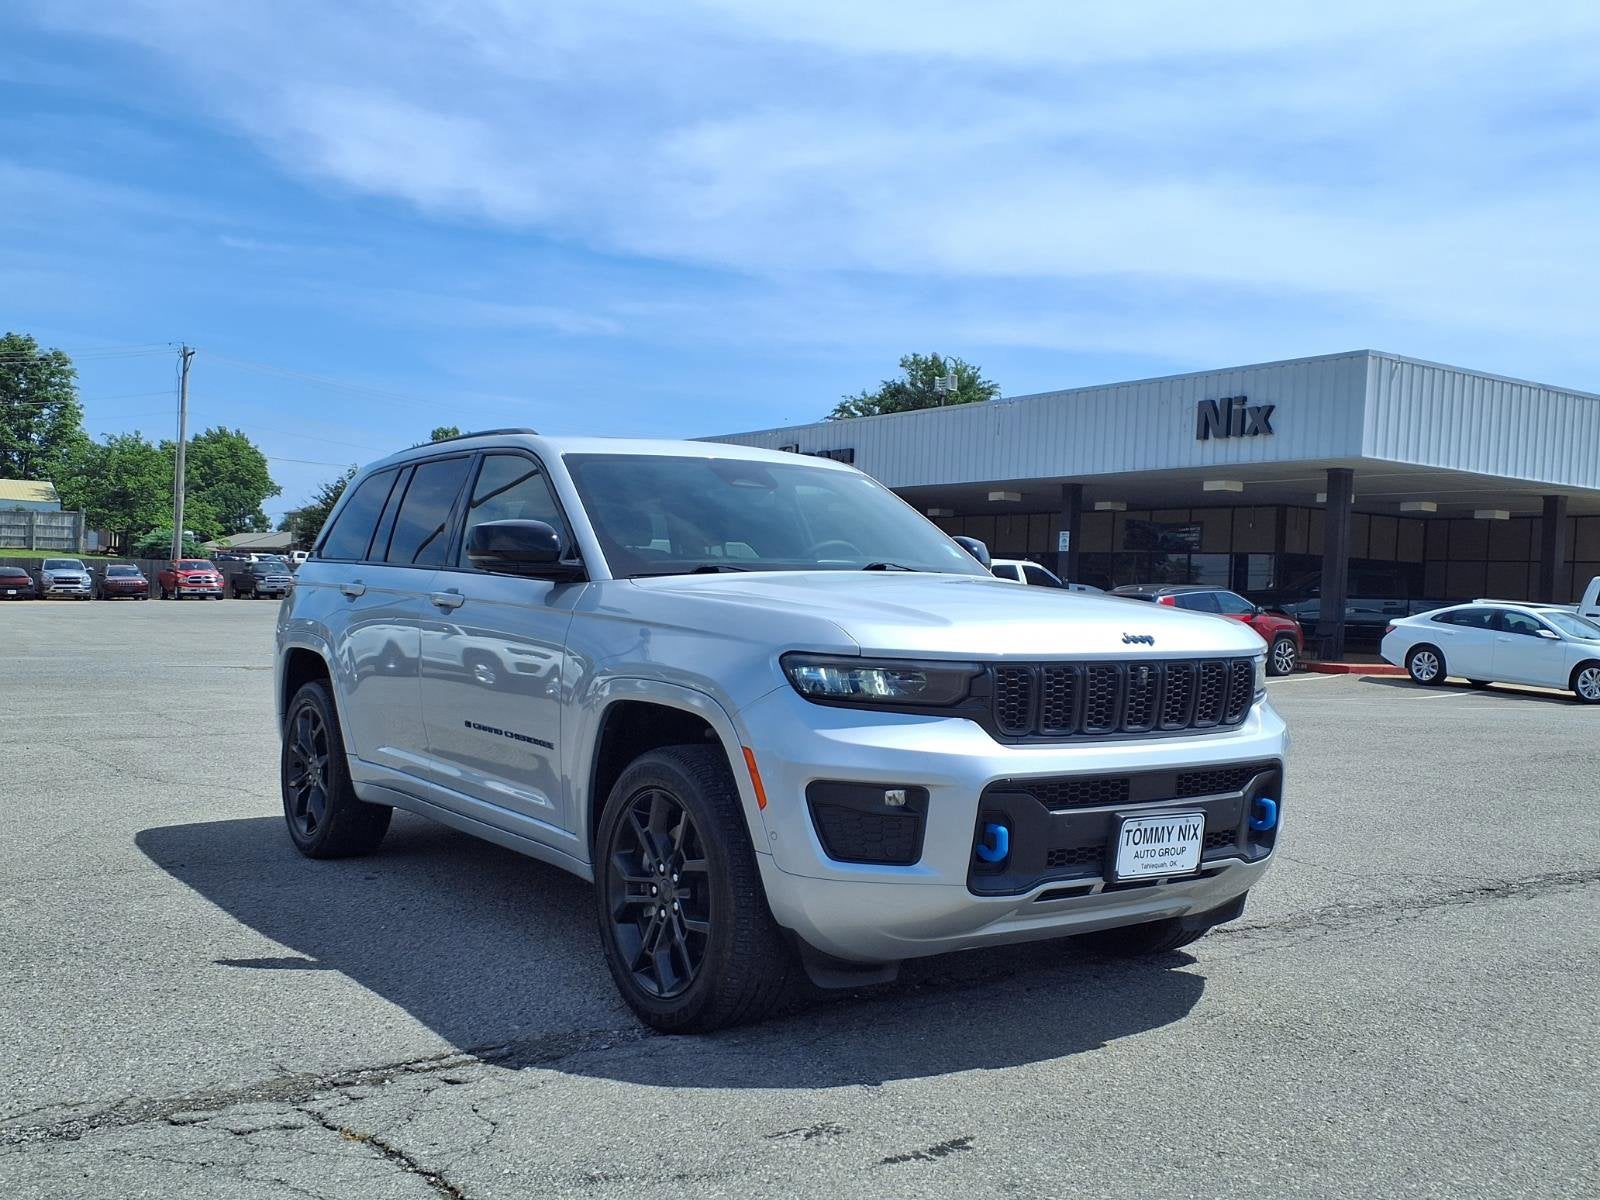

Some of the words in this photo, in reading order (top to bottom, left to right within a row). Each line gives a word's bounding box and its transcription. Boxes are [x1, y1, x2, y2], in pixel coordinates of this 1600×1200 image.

[1196, 395, 1276, 440] Nix
[1121, 632, 1155, 647] Jeep
[1125, 825, 1175, 846] TOMMY
[1177, 823, 1200, 841] NIX
[1133, 848, 1157, 860] AUTO
[1158, 846, 1187, 857] GROUP
